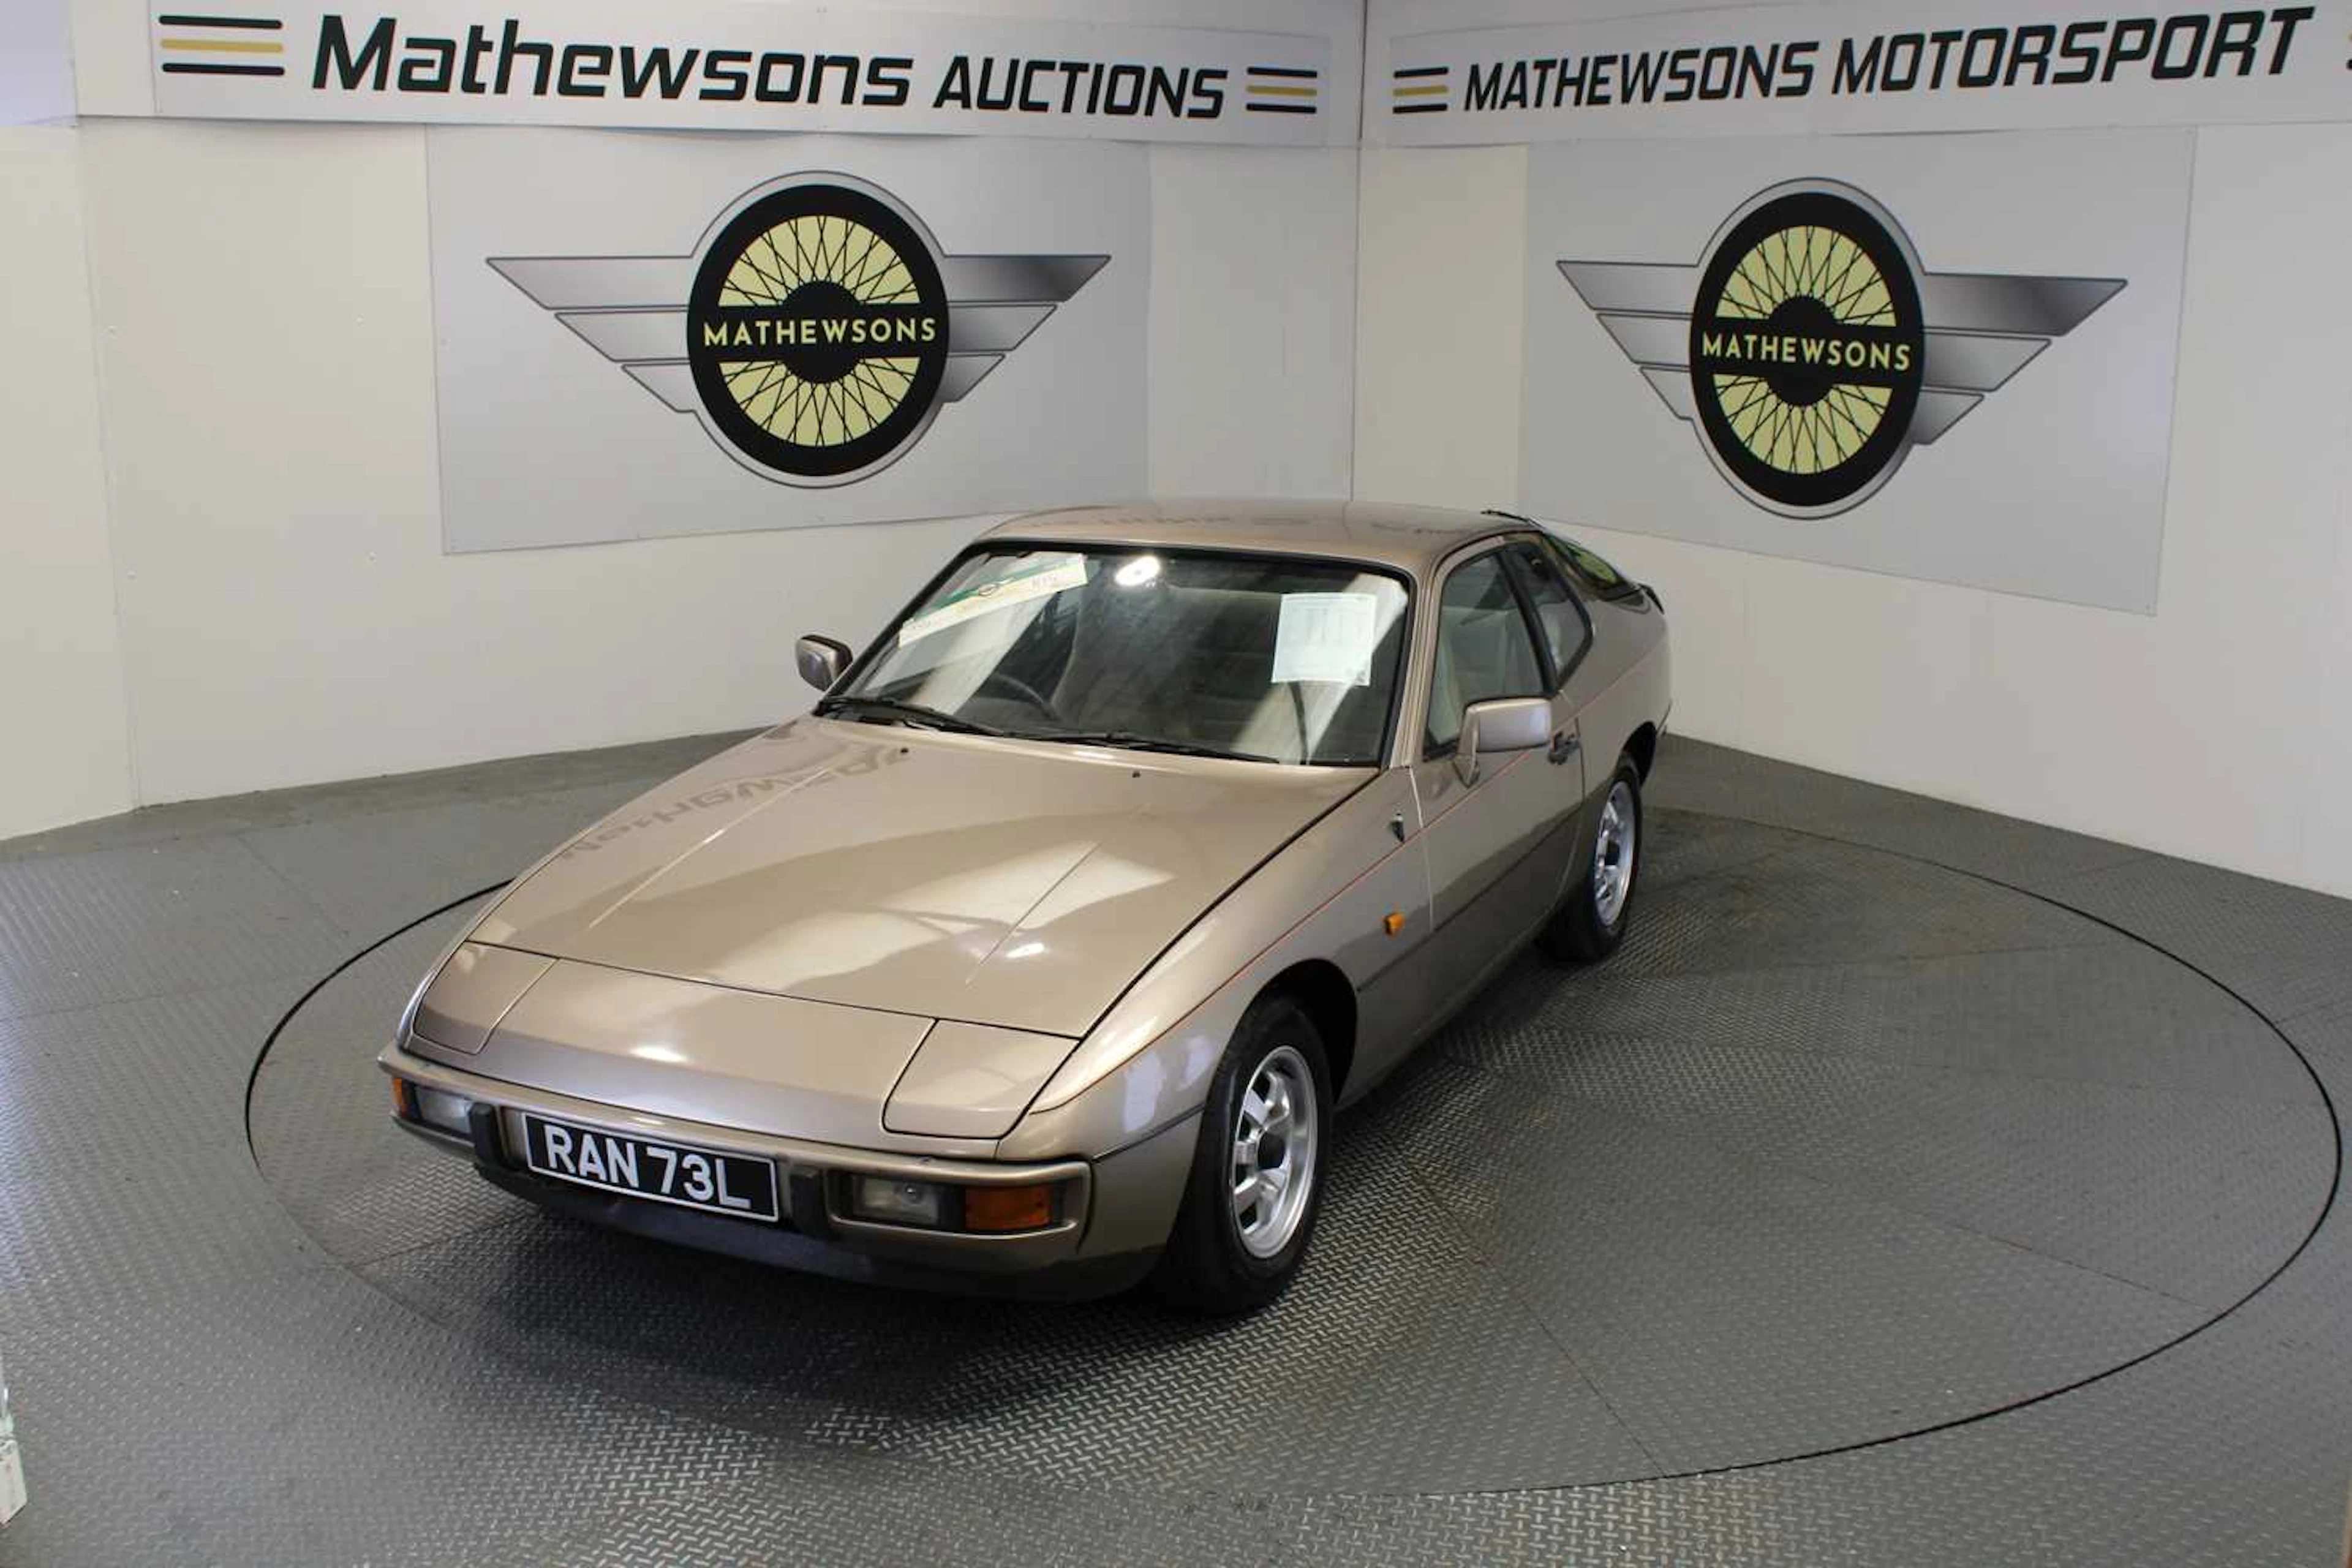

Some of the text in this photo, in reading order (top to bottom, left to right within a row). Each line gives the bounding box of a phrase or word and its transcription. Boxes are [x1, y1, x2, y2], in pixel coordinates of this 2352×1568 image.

[312, 15, 1229, 119] Mathewsons AUCTIONS
[1464, 6, 2315, 111] MATHEWSONS MOTORSPORT
[704, 317, 936, 347] MATHEWSONS
[1703, 333, 1910, 371] MATHEWSONS
[544, 1125, 752, 1209] RAN 73L
